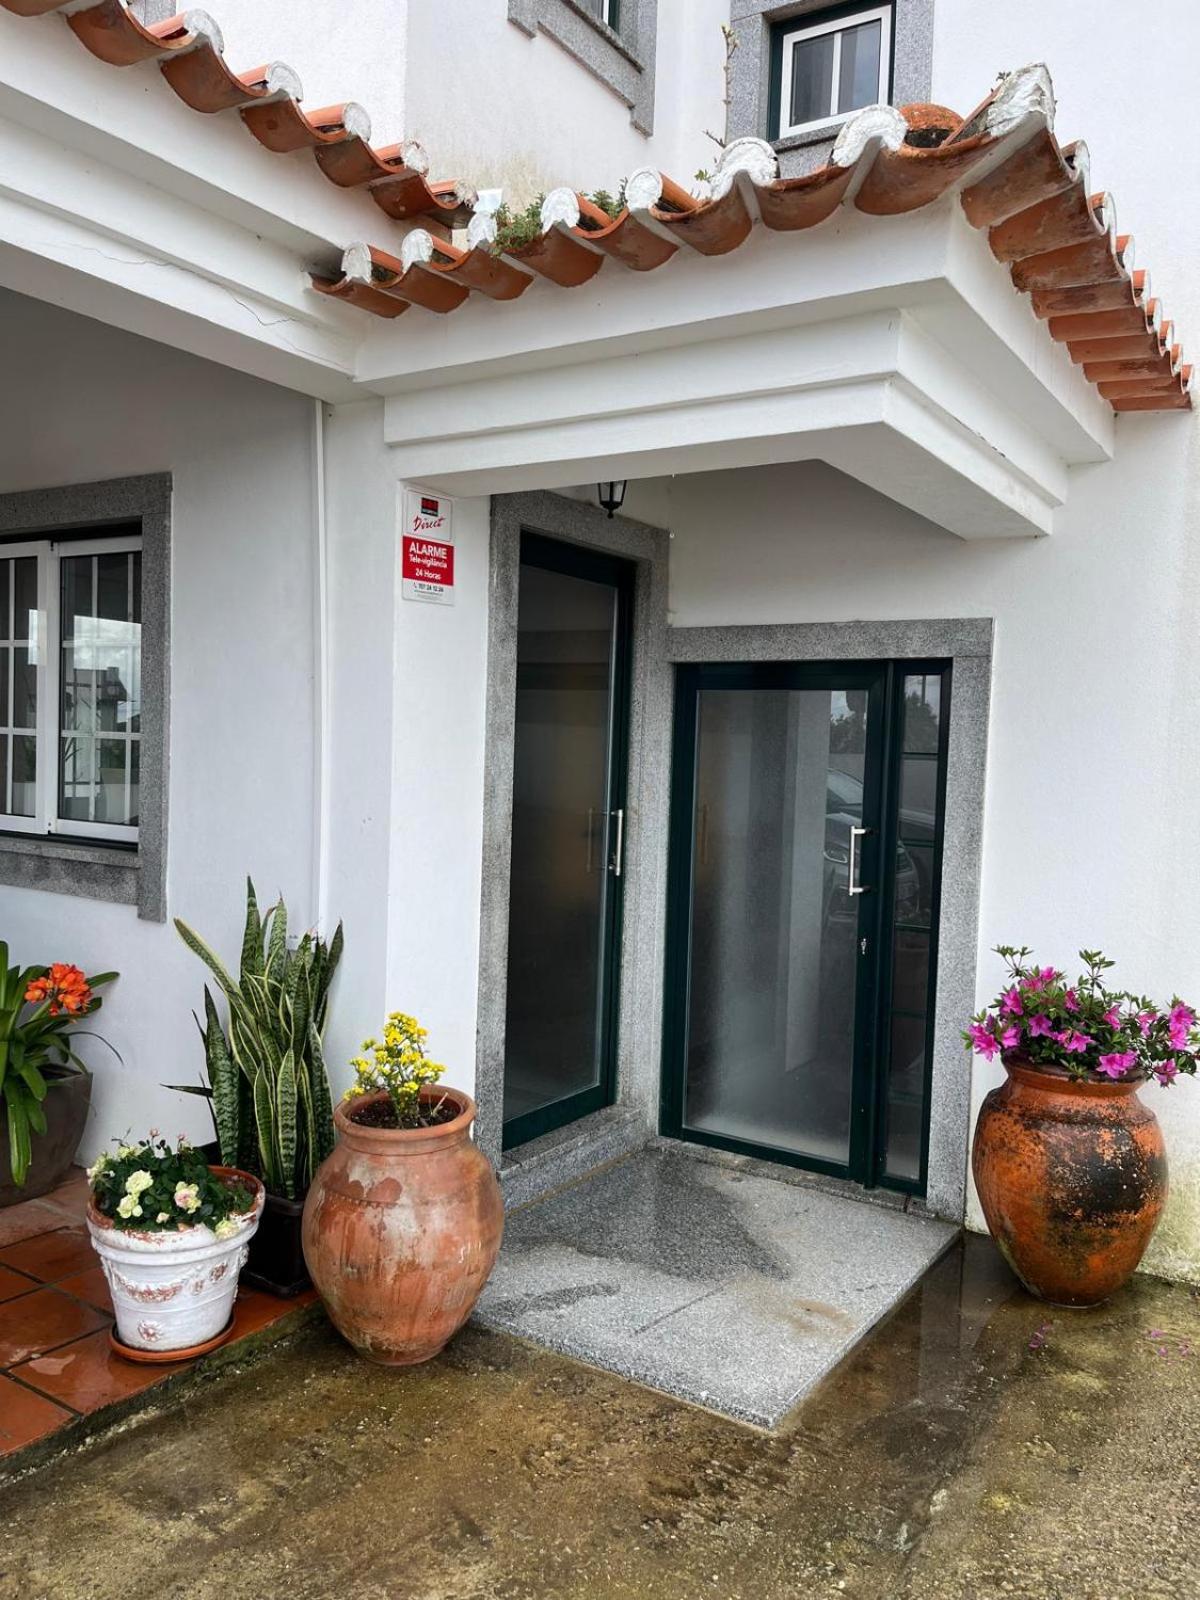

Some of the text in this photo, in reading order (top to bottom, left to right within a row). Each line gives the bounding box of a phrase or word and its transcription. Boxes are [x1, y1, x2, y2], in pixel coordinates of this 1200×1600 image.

[409, 541, 448, 559] ALARME
[415, 567, 442, 580] 24 Horas
